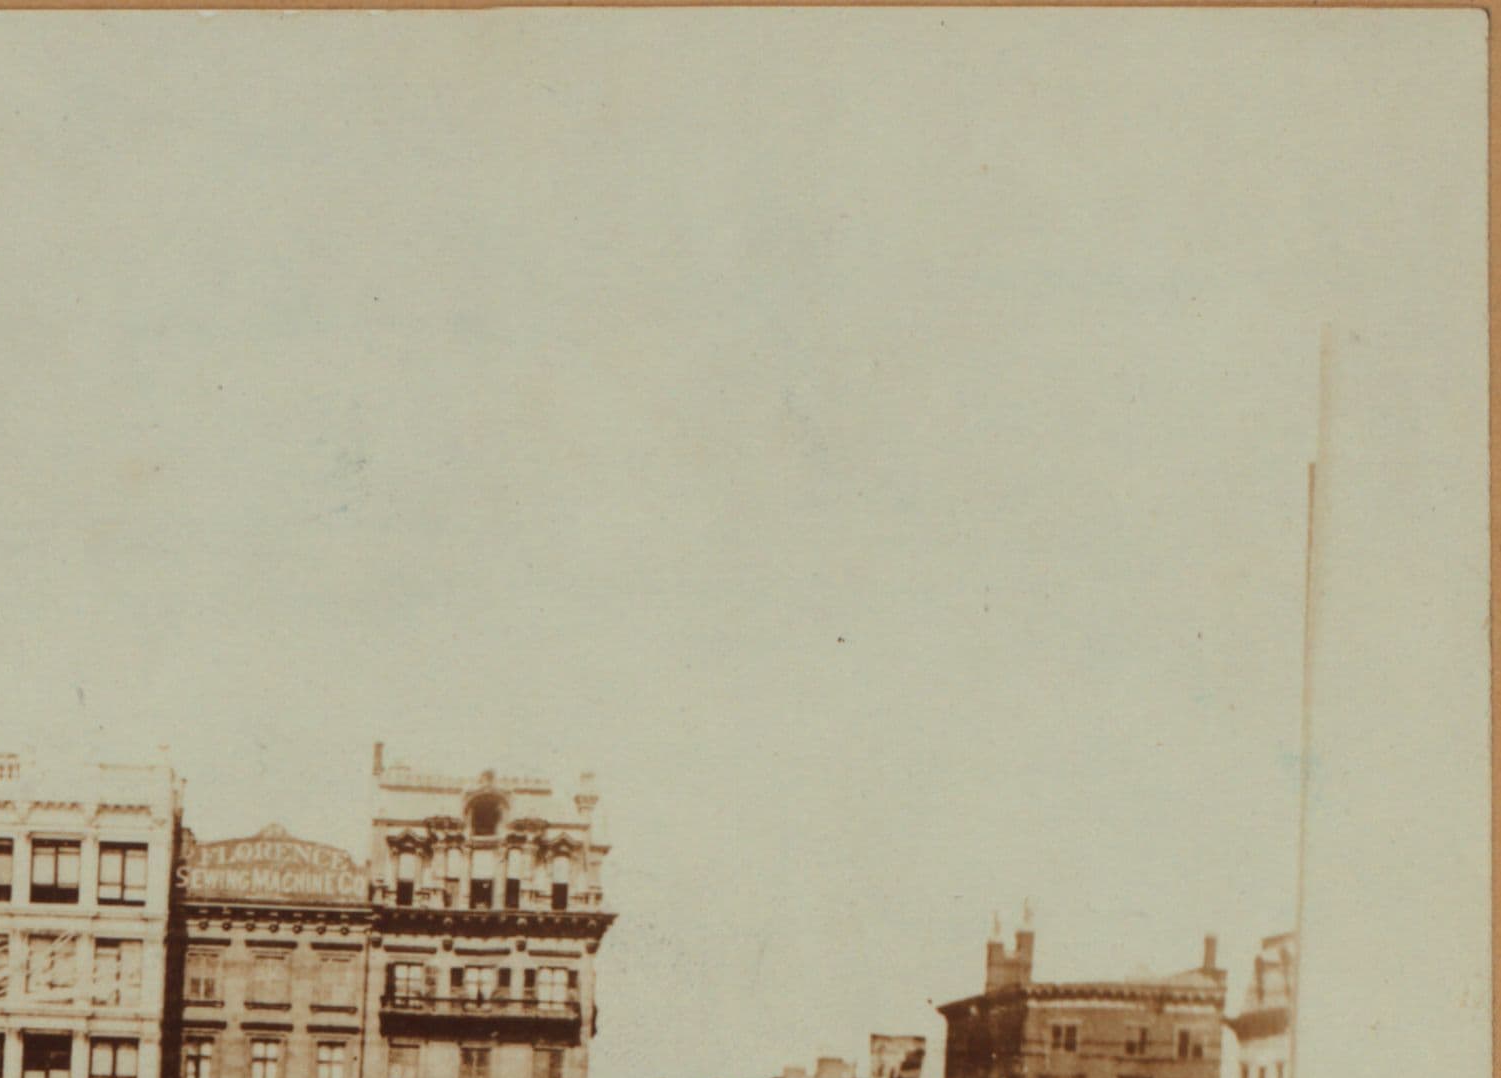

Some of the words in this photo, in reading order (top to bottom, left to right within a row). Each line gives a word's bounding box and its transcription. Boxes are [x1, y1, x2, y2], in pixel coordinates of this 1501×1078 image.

[199, 842, 350, 869] FLORENCE
[175, 865, 250, 891] SEWING
[251, 867, 335, 895] MACHINE
